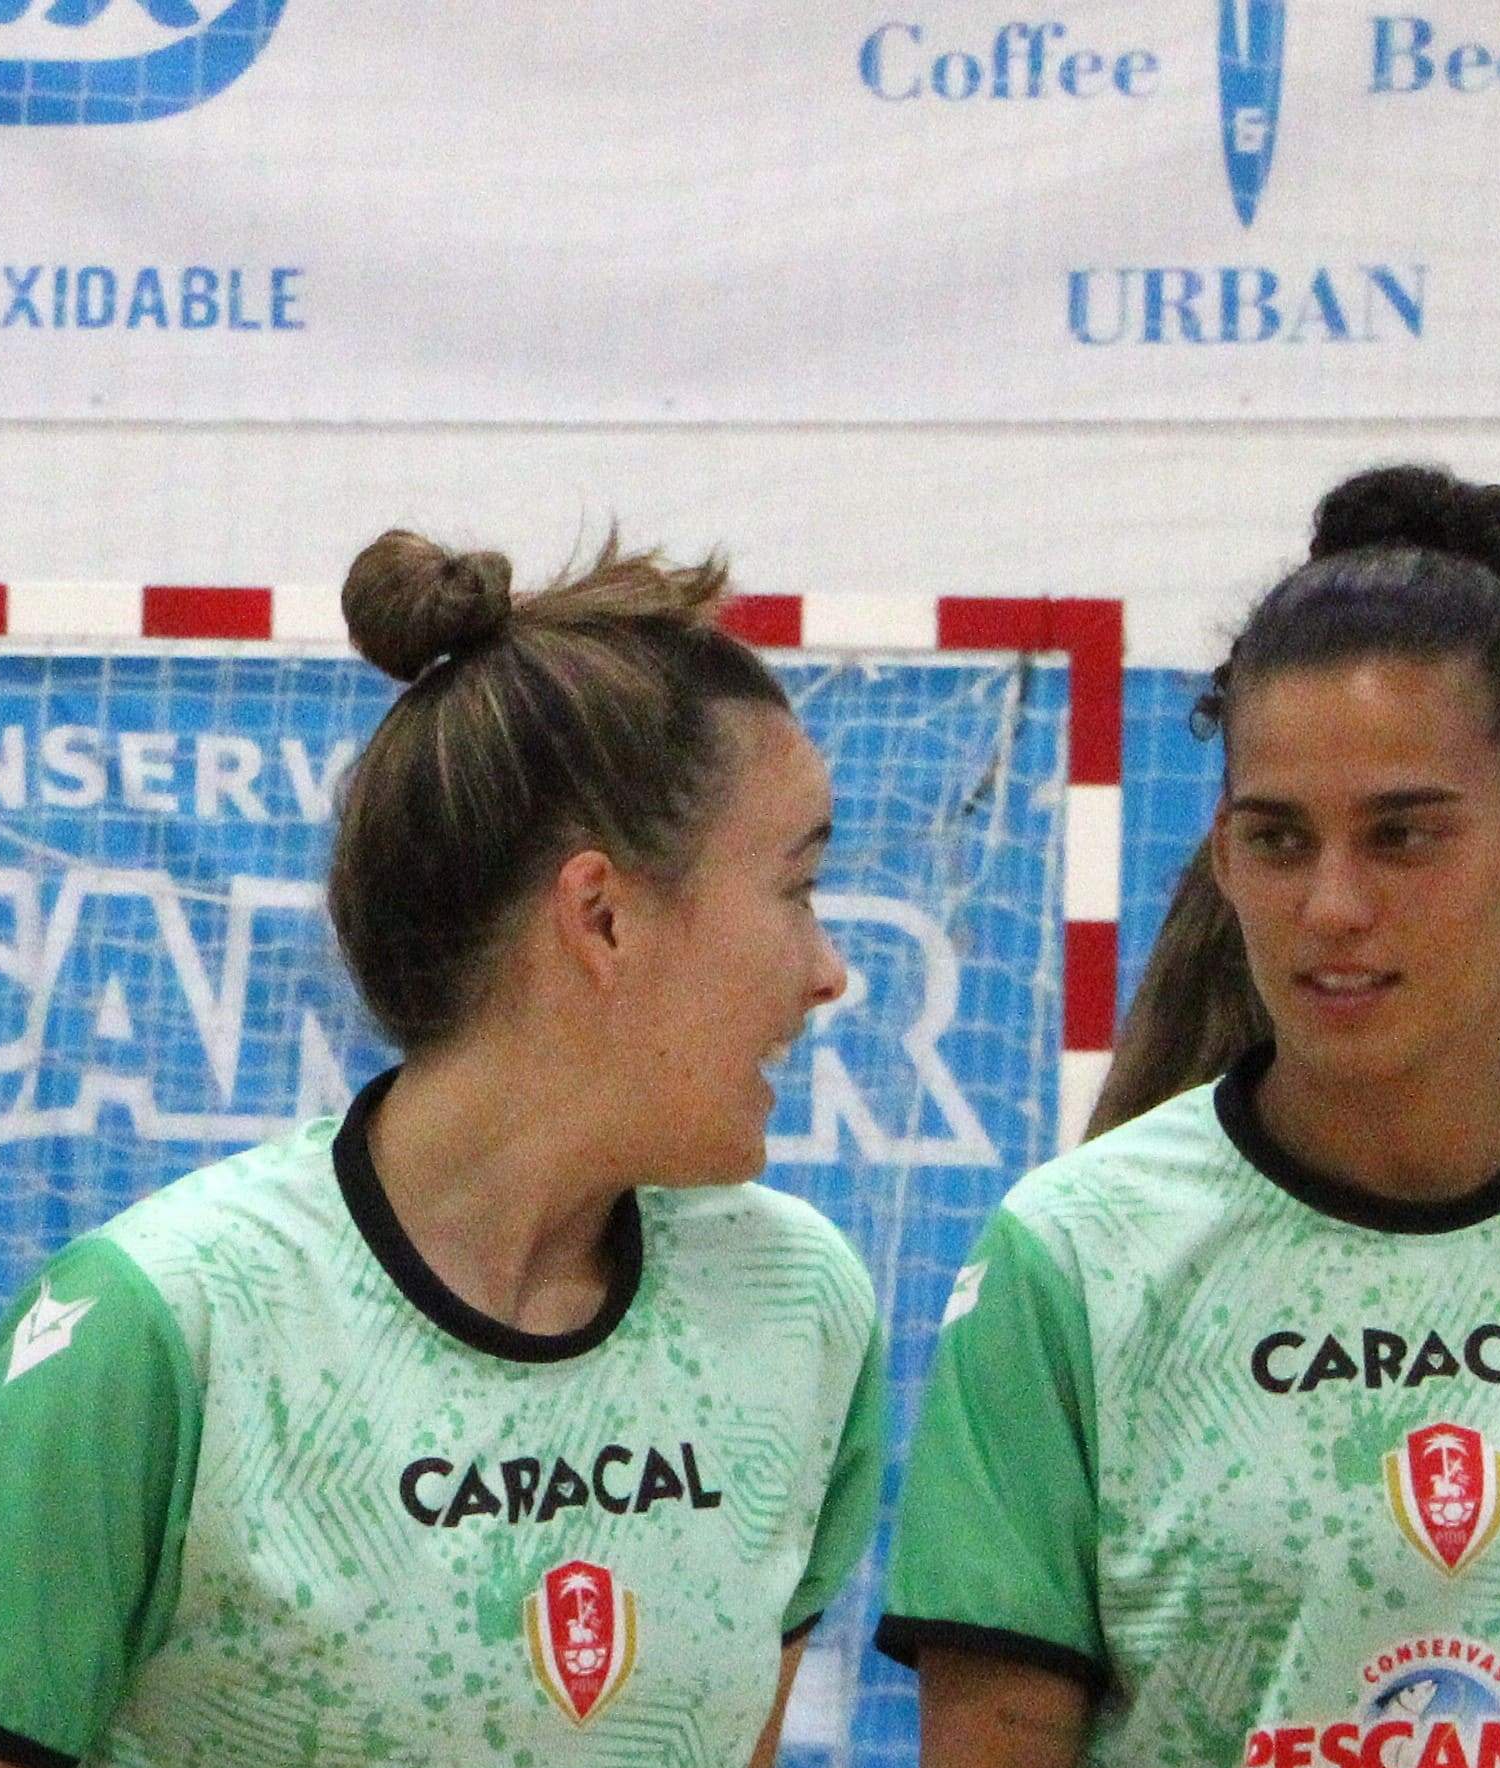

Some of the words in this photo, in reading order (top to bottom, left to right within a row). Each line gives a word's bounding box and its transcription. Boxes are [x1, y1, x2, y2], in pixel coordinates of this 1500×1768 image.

[858, 20, 1160, 102] Coffee
[1065, 263, 1427, 346] URBAN
[399, 1442, 722, 1527] CARACAL
